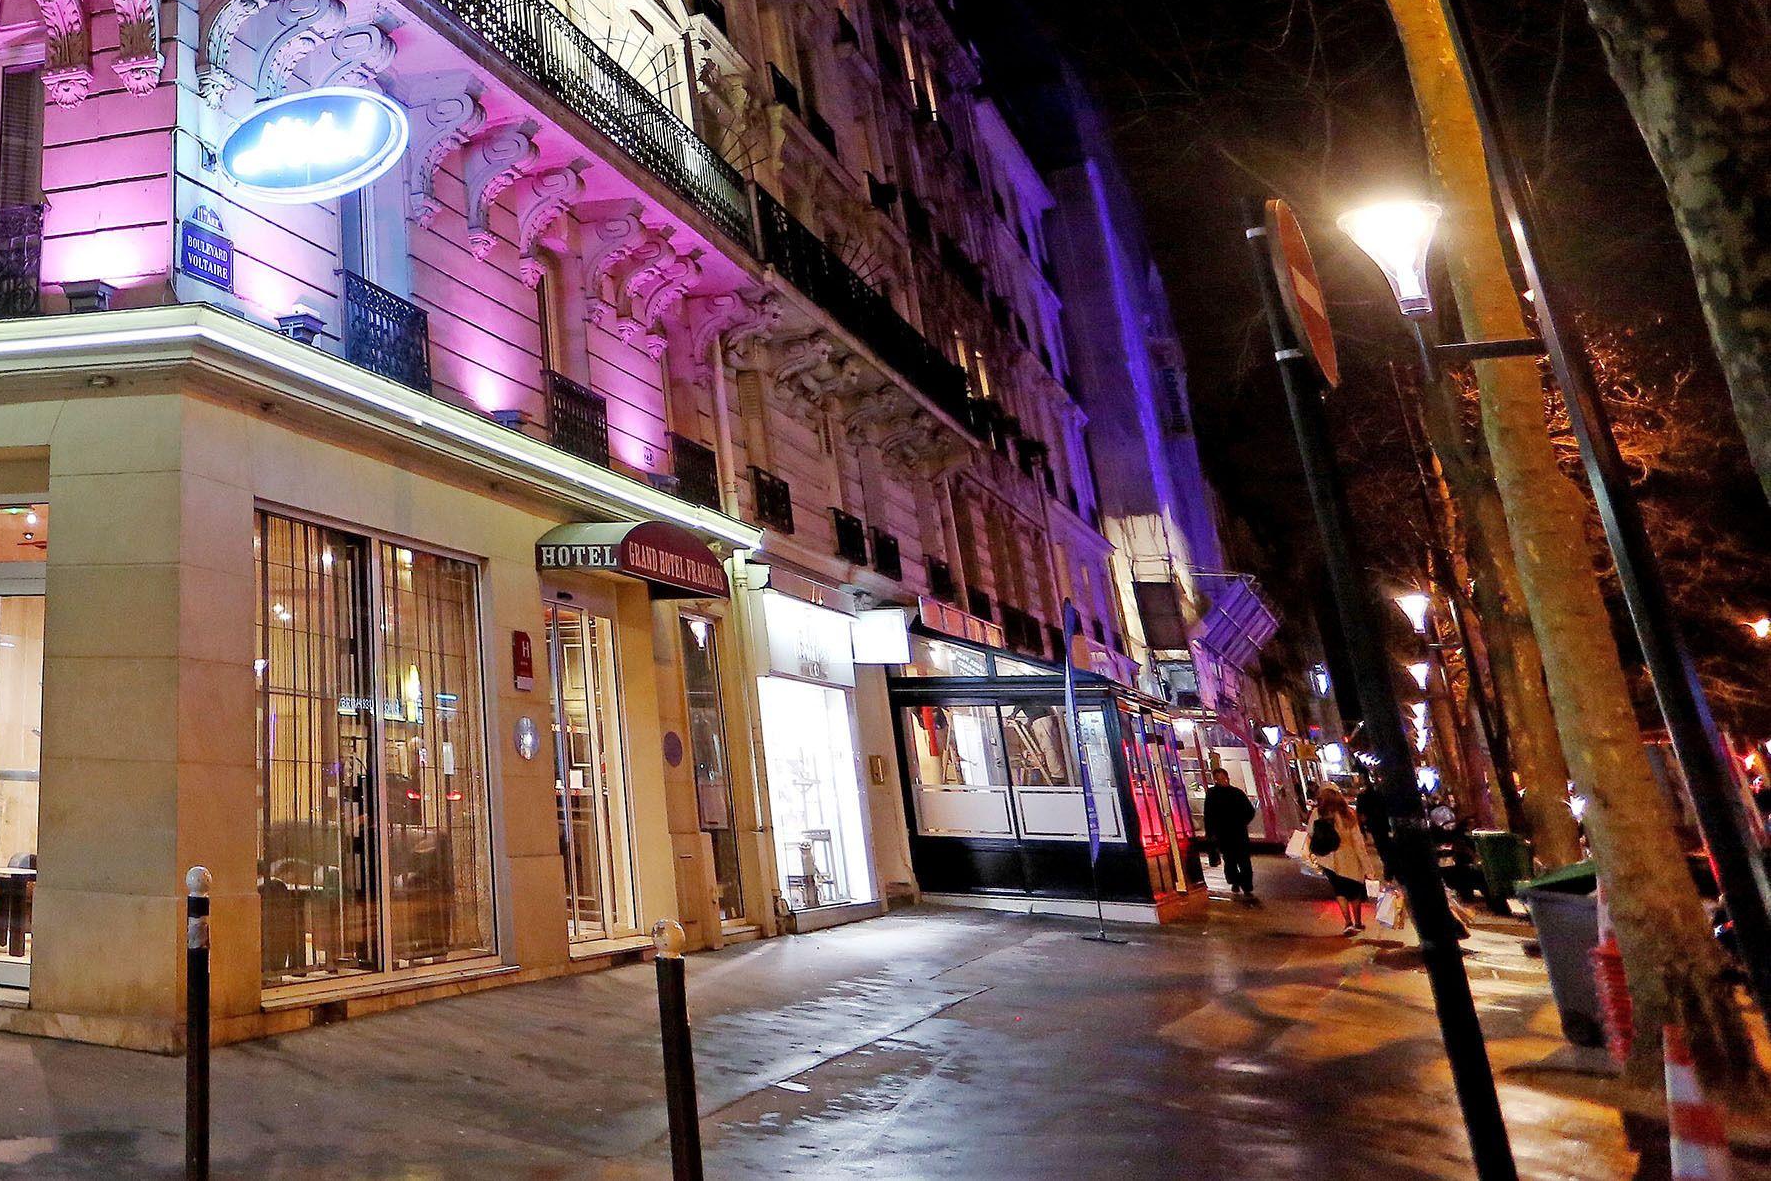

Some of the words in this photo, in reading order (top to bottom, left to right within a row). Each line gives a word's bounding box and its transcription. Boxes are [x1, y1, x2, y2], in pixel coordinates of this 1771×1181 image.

[187, 234, 228, 262] BOULEVARD
[187, 252, 229, 280] VOLTAIRE
[540, 545, 618, 567] HOTEL
[628, 540, 658, 572] GRAND
[659, 549, 686, 580] HOTEL
[521, 640, 530, 659] H
